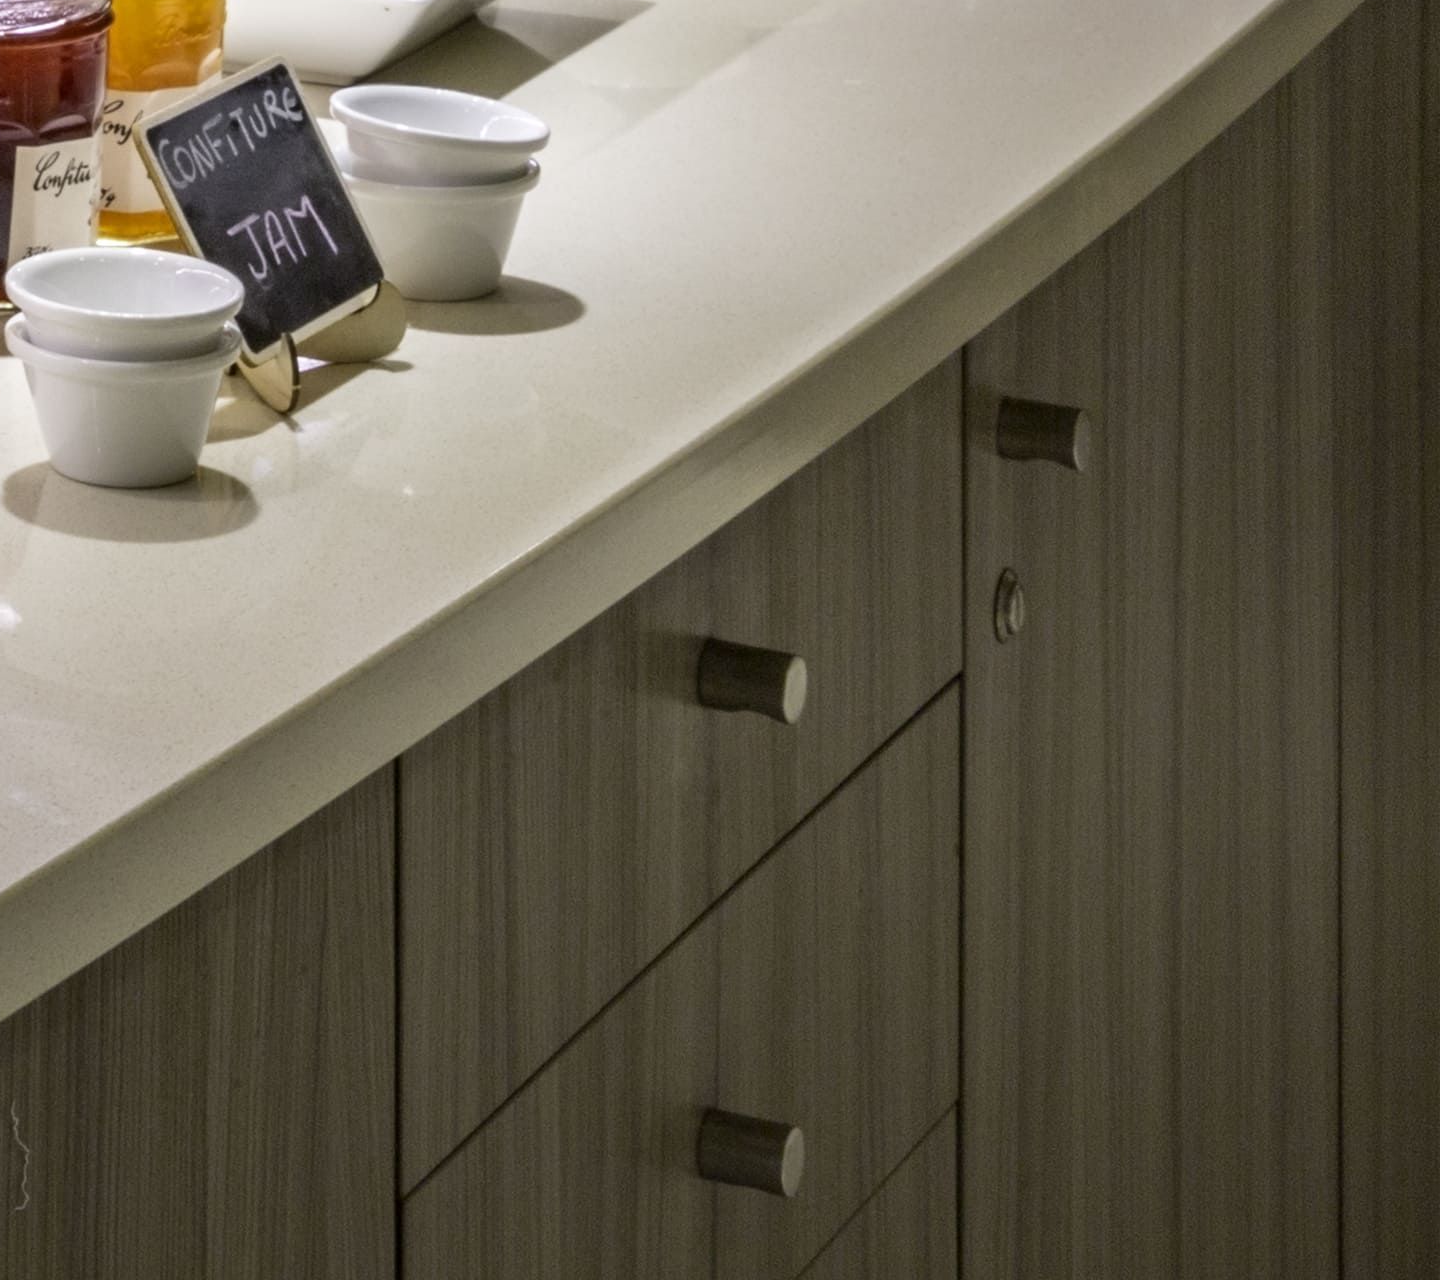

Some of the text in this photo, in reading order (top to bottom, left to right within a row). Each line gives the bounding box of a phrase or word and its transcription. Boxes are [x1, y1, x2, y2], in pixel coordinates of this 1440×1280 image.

[33, 150, 93, 198] Confitu
[157, 87, 304, 190] CONFITURE
[226, 194, 339, 281] JAM
